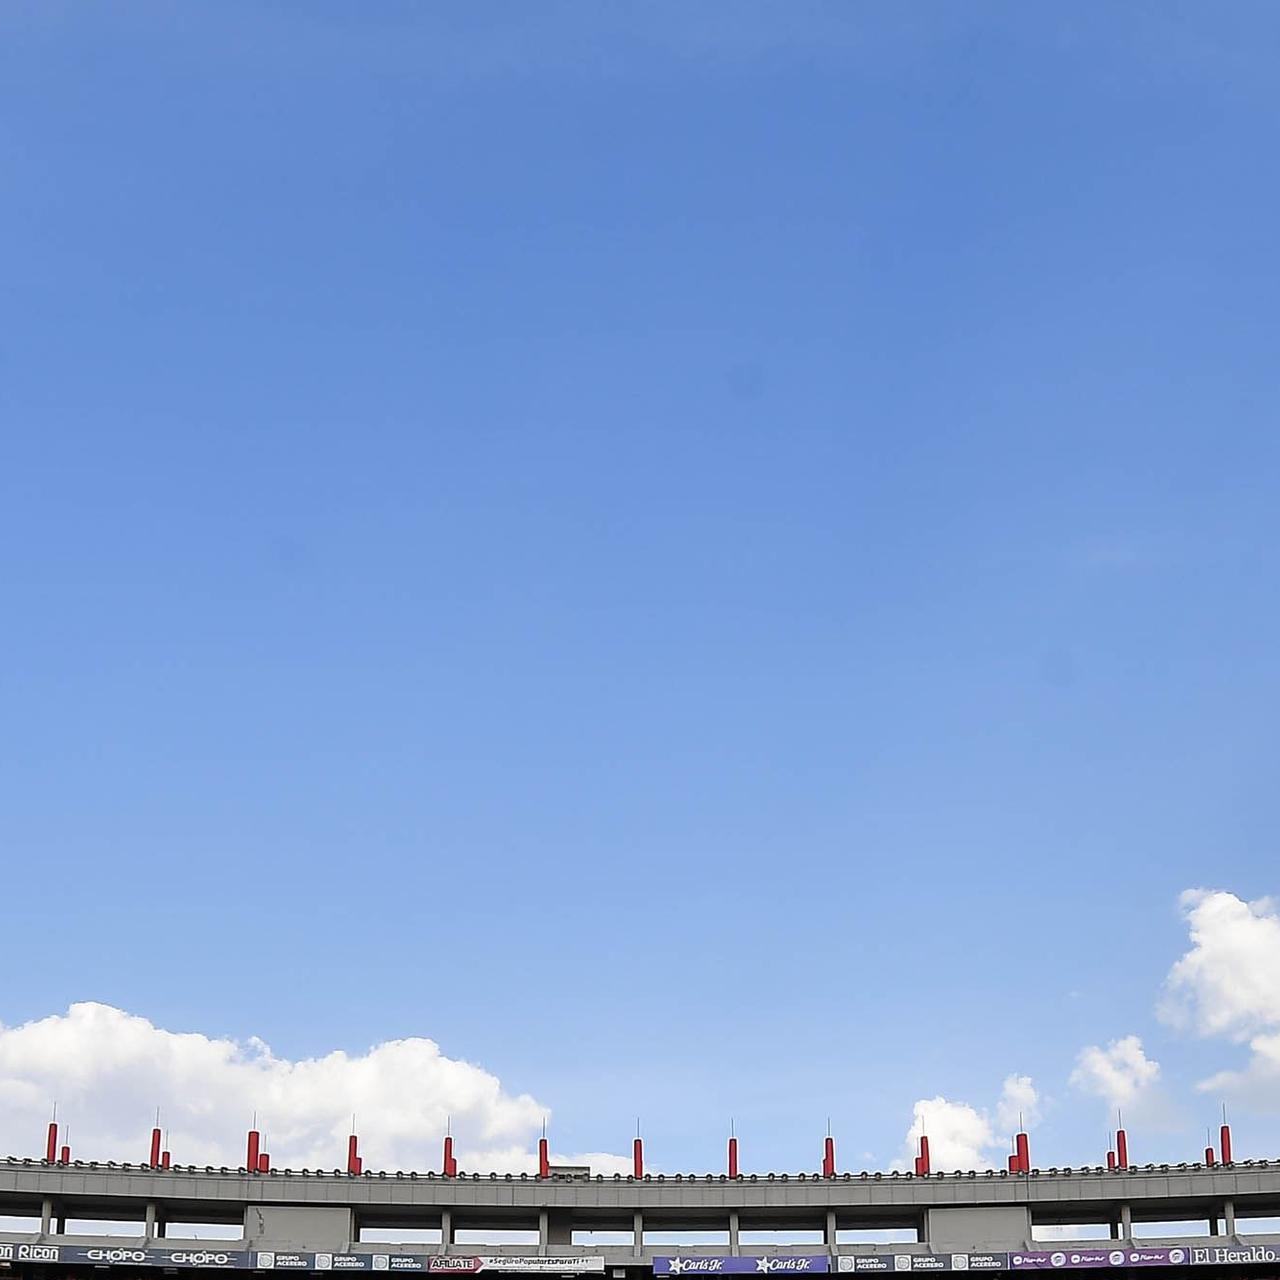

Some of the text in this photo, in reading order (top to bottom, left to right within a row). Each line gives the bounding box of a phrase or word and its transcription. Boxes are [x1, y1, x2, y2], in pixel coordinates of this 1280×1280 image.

[18, 1245, 60, 1262] Ricon
[87, 1249, 146, 1263] CHOPO
[171, 1251, 229, 1265] CHOPO
[1194, 1246, 1276, 1263] El Heraldo
[682, 1258, 708, 1271] Carl's
[769, 1258, 795, 1271] Carl's
